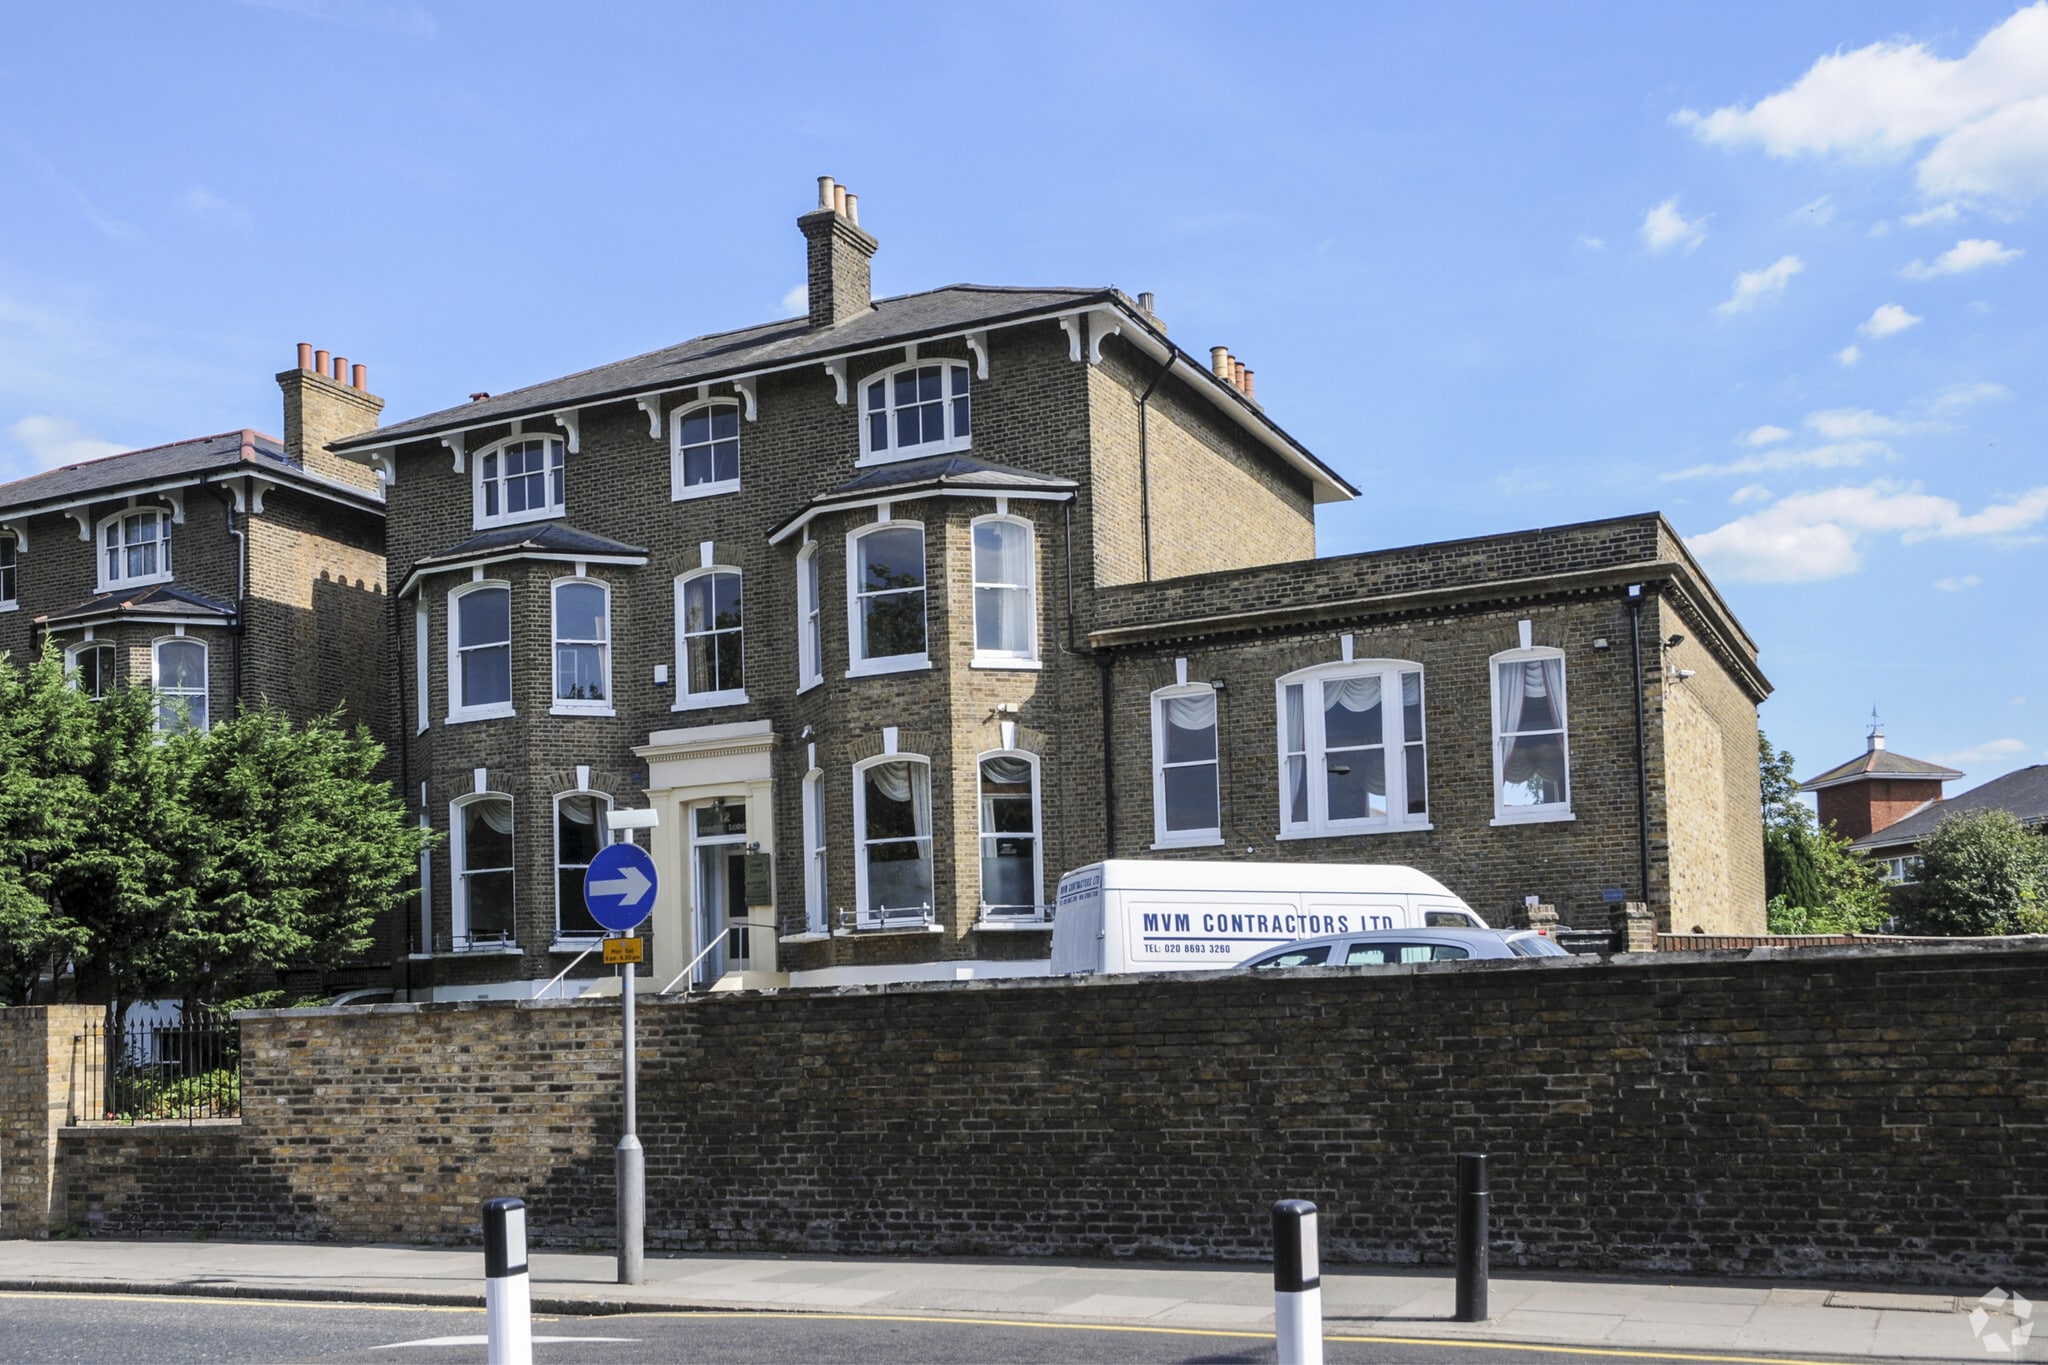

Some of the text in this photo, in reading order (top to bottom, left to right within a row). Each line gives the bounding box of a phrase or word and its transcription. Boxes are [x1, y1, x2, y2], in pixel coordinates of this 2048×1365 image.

[1143, 913, 1190, 932] MVM
[1203, 913, 1349, 934] CONTRACTORS
[1144, 944, 1231, 953] TEL: 020 8693 3260
